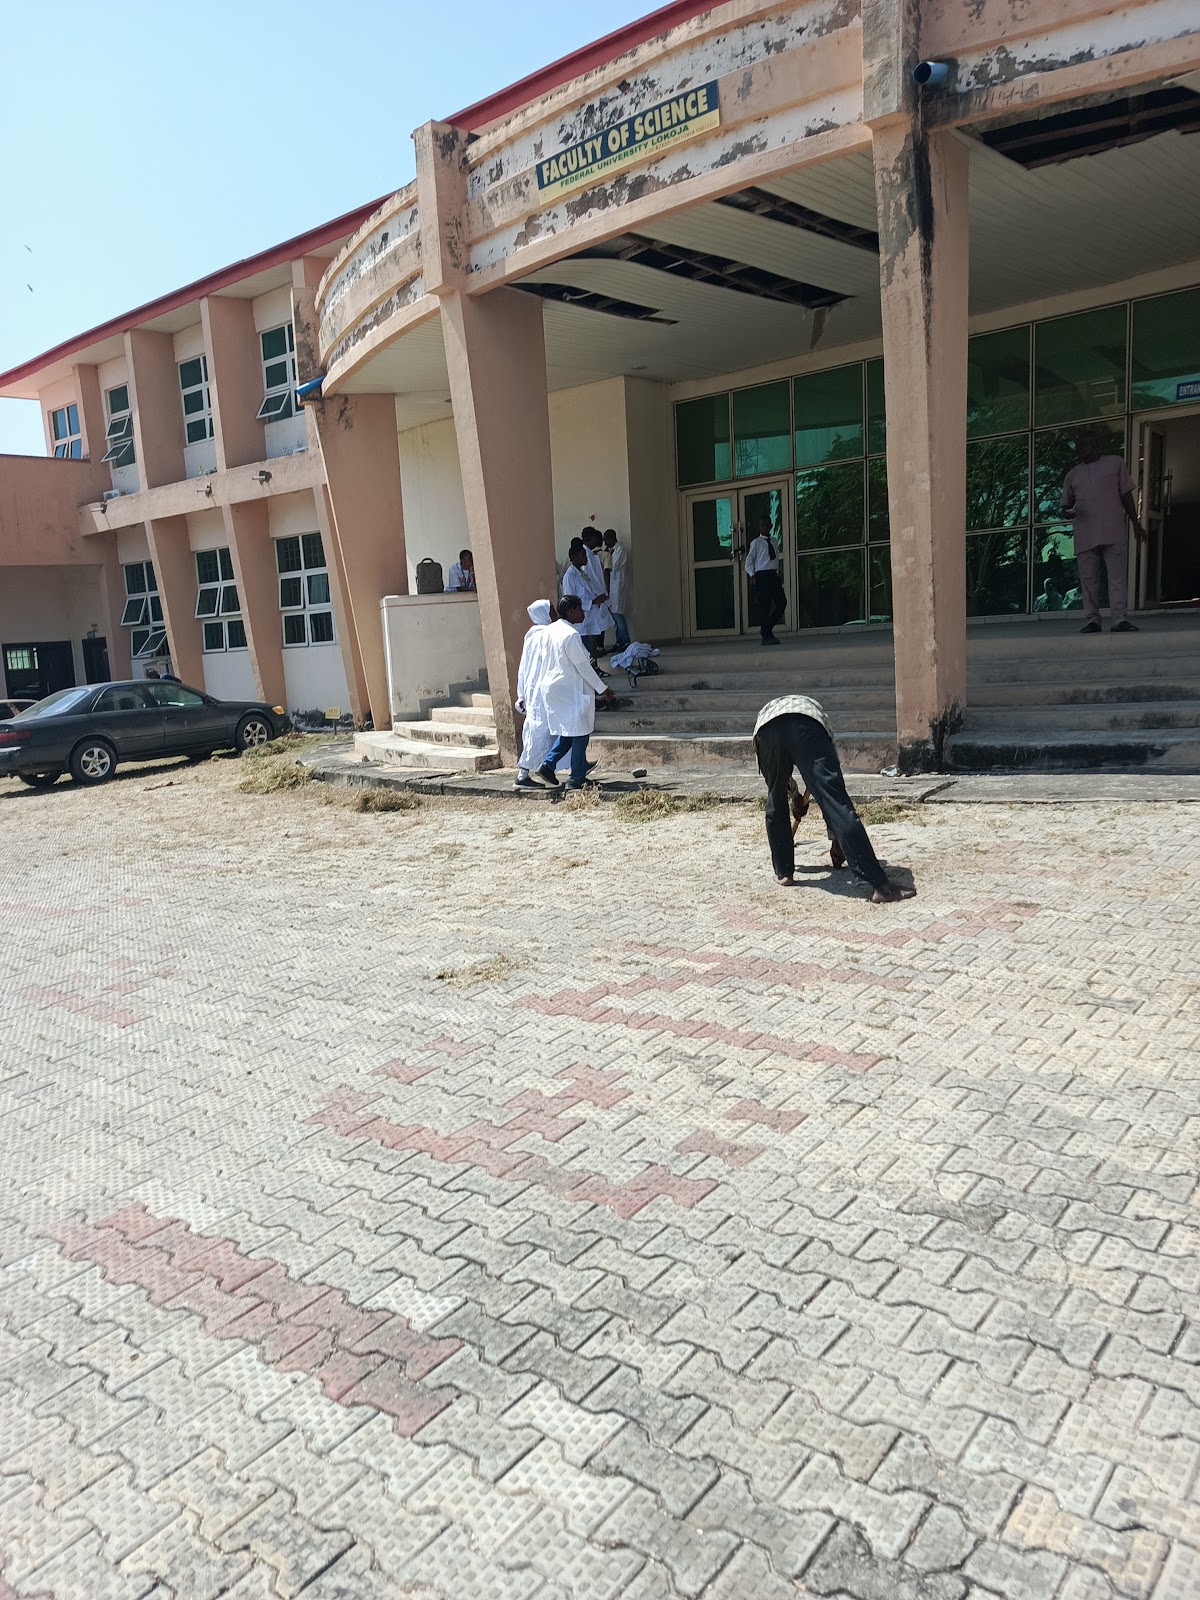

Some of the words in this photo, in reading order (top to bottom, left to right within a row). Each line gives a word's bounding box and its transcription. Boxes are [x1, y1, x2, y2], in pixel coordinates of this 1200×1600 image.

[542, 136, 602, 185] FACULTY
[608, 123, 630, 153] OF
[634, 88, 708, 141] SCIENCE
[560, 167, 595, 188] FEDERAL
[597, 142, 649, 171] UNIVERSITY
[651, 124, 690, 146] LOKOJA
